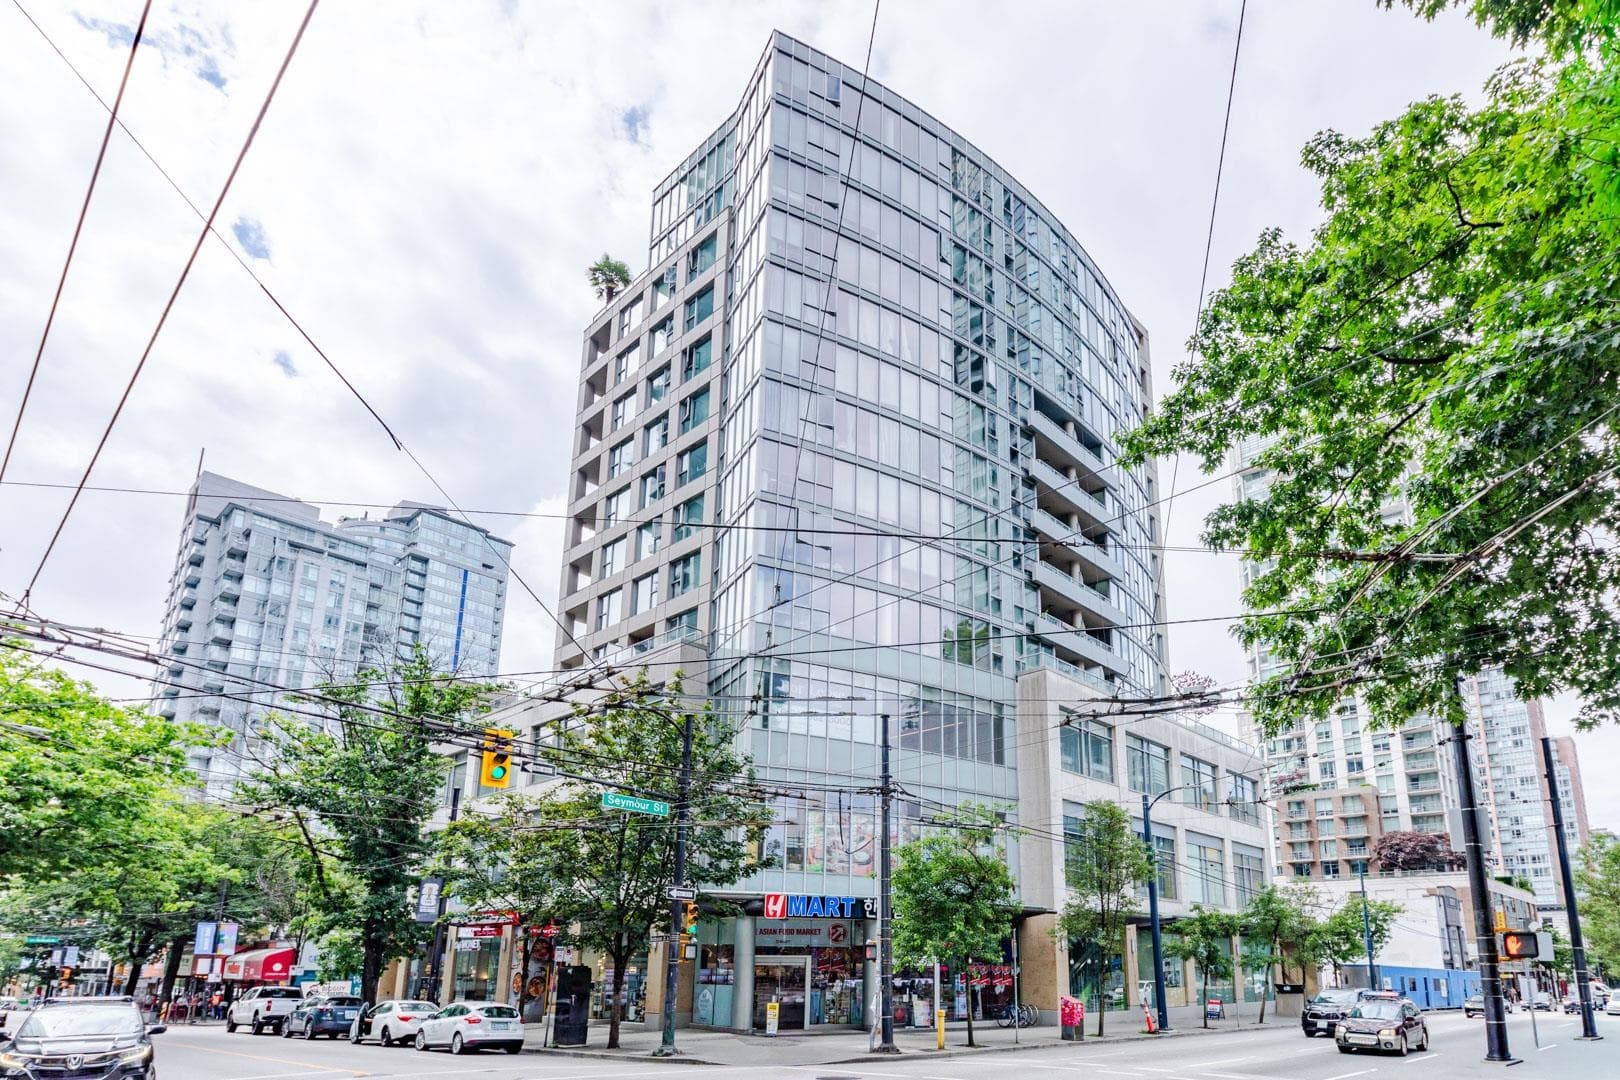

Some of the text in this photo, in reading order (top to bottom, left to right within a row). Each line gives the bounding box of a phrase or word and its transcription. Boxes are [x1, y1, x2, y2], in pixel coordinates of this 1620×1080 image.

[607, 794, 664, 813] Seymour St
[787, 895, 856, 918] MART
[758, 928, 778, 936] ASIAN
[795, 928, 822, 936] MARKET
